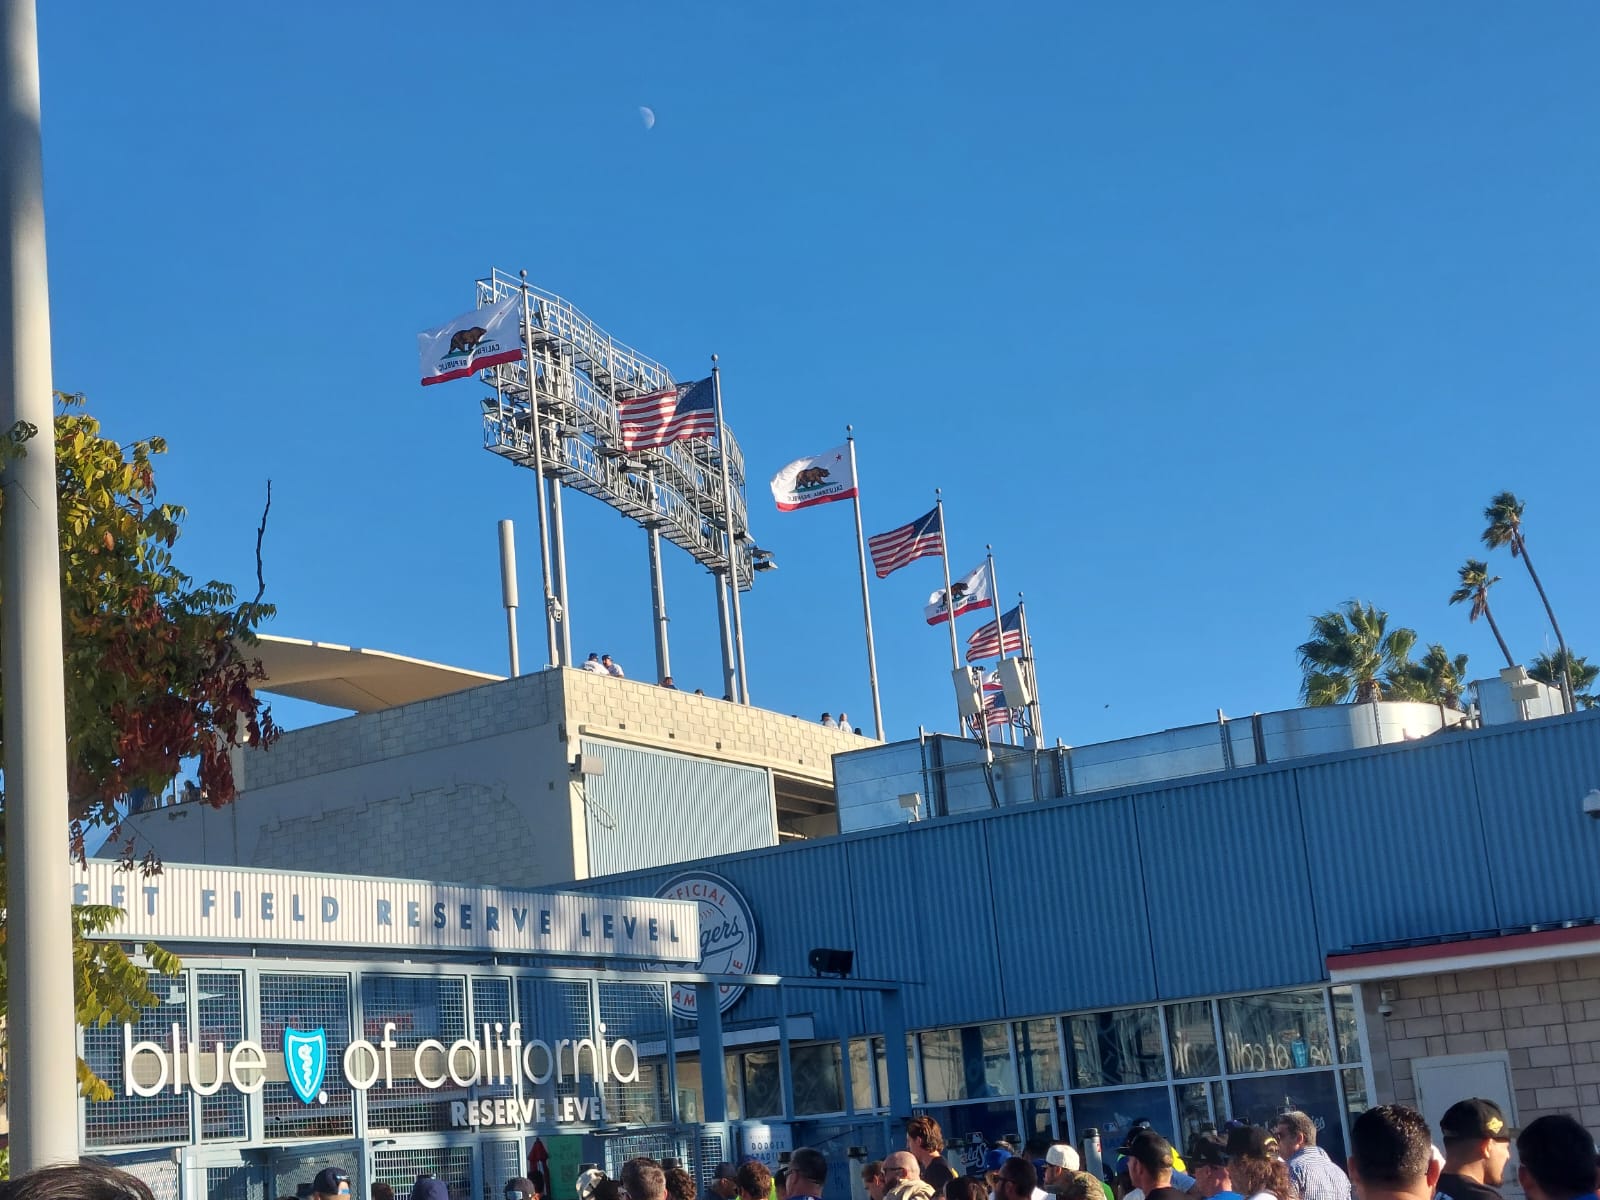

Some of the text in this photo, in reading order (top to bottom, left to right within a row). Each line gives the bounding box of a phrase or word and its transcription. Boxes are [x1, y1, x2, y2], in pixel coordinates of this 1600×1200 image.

[73, 883, 680, 943] EFT FIELD RESERVE LEVEL
[668, 884, 727, 907] FICIAL
[123, 1022, 640, 1097] blue of california
[451, 1096, 611, 1127] RESERVE LEVEL
